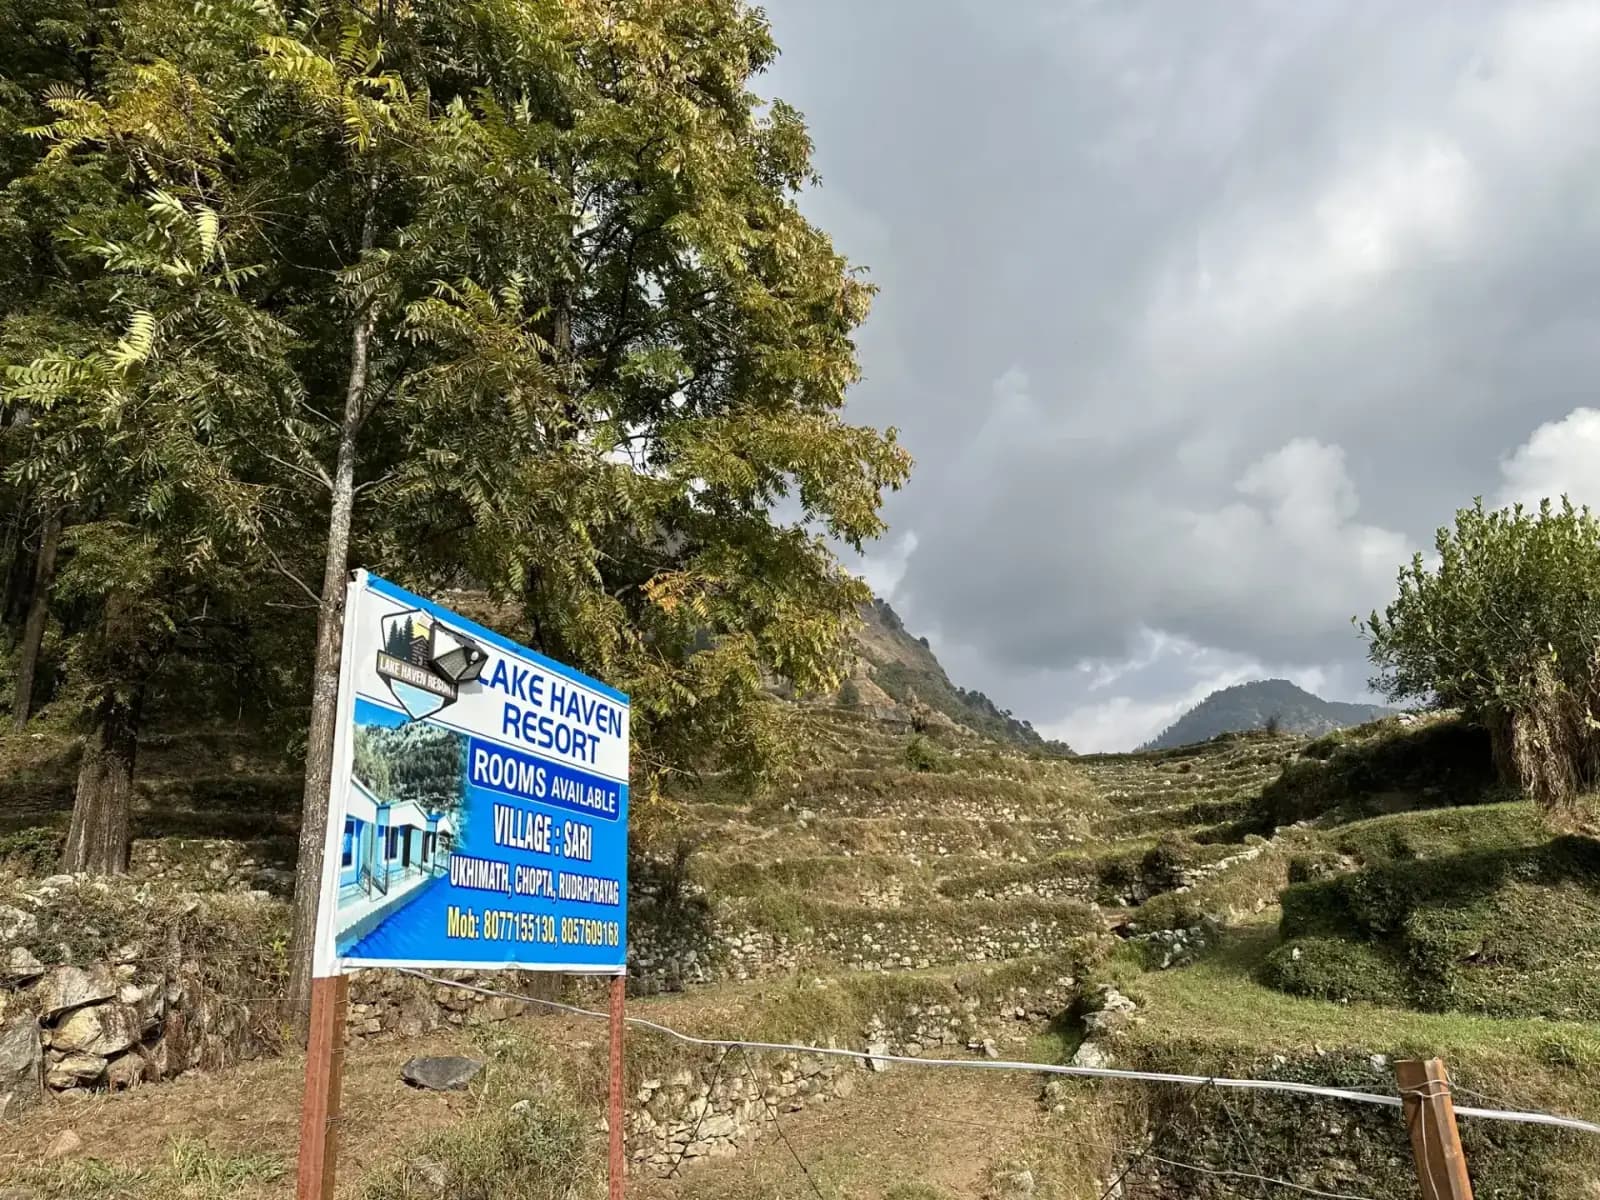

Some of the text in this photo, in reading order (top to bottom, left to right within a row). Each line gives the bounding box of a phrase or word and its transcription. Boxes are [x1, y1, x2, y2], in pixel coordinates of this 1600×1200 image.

[380, 656, 400, 675] LAKE
[401, 665, 427, 687] HAVEN
[478, 659, 622, 738] AKE HAVEN
[503, 702, 600, 764] RESORT
[474, 748, 615, 814] ROOMS AVAILABLE
[493, 804, 552, 854] VILLAGE
[564, 820, 593, 861] SARI
[450, 855, 619, 905] UKHIMATH, CHOPTA, RUDRAPRAYAG
[447, 906, 619, 946] Mob: 8077155130, 8057609168
